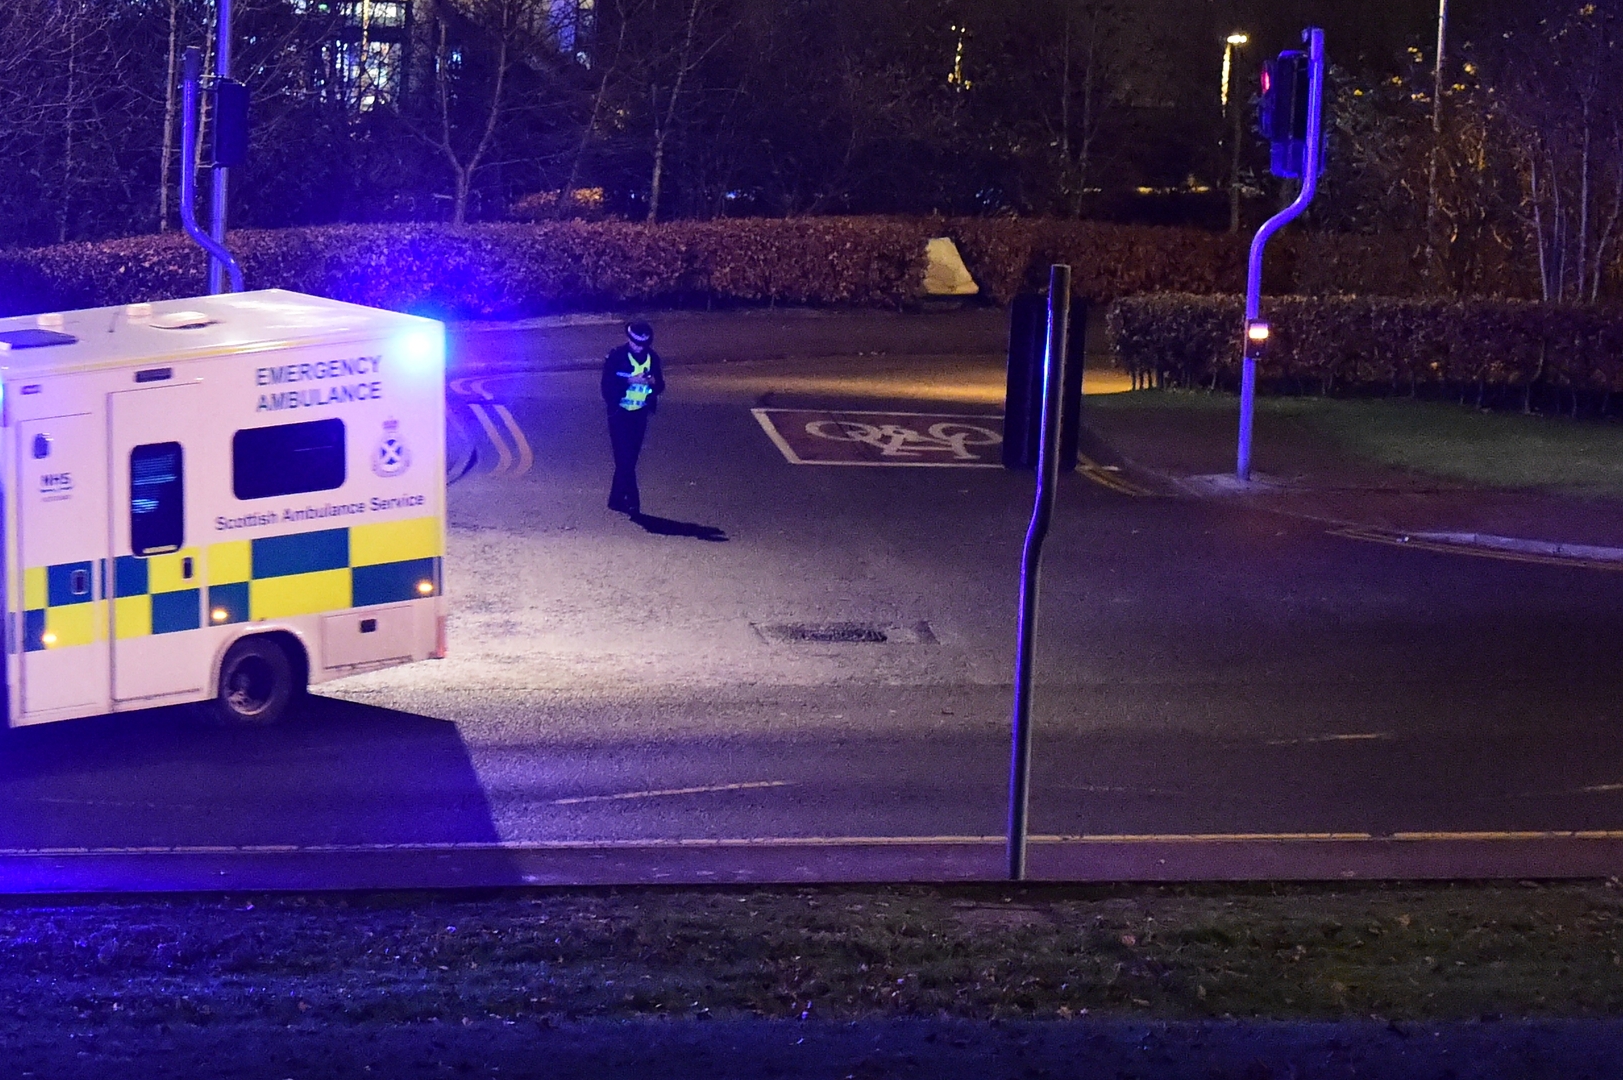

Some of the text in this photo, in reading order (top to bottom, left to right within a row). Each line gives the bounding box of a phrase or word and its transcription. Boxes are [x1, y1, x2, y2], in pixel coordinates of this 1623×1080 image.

[256, 355, 382, 386] EMERGENCY
[256, 381, 382, 412] AMBULANCE
[40, 472, 71, 487] NHS
[215, 493, 426, 531] Scottish Ambulance Service
